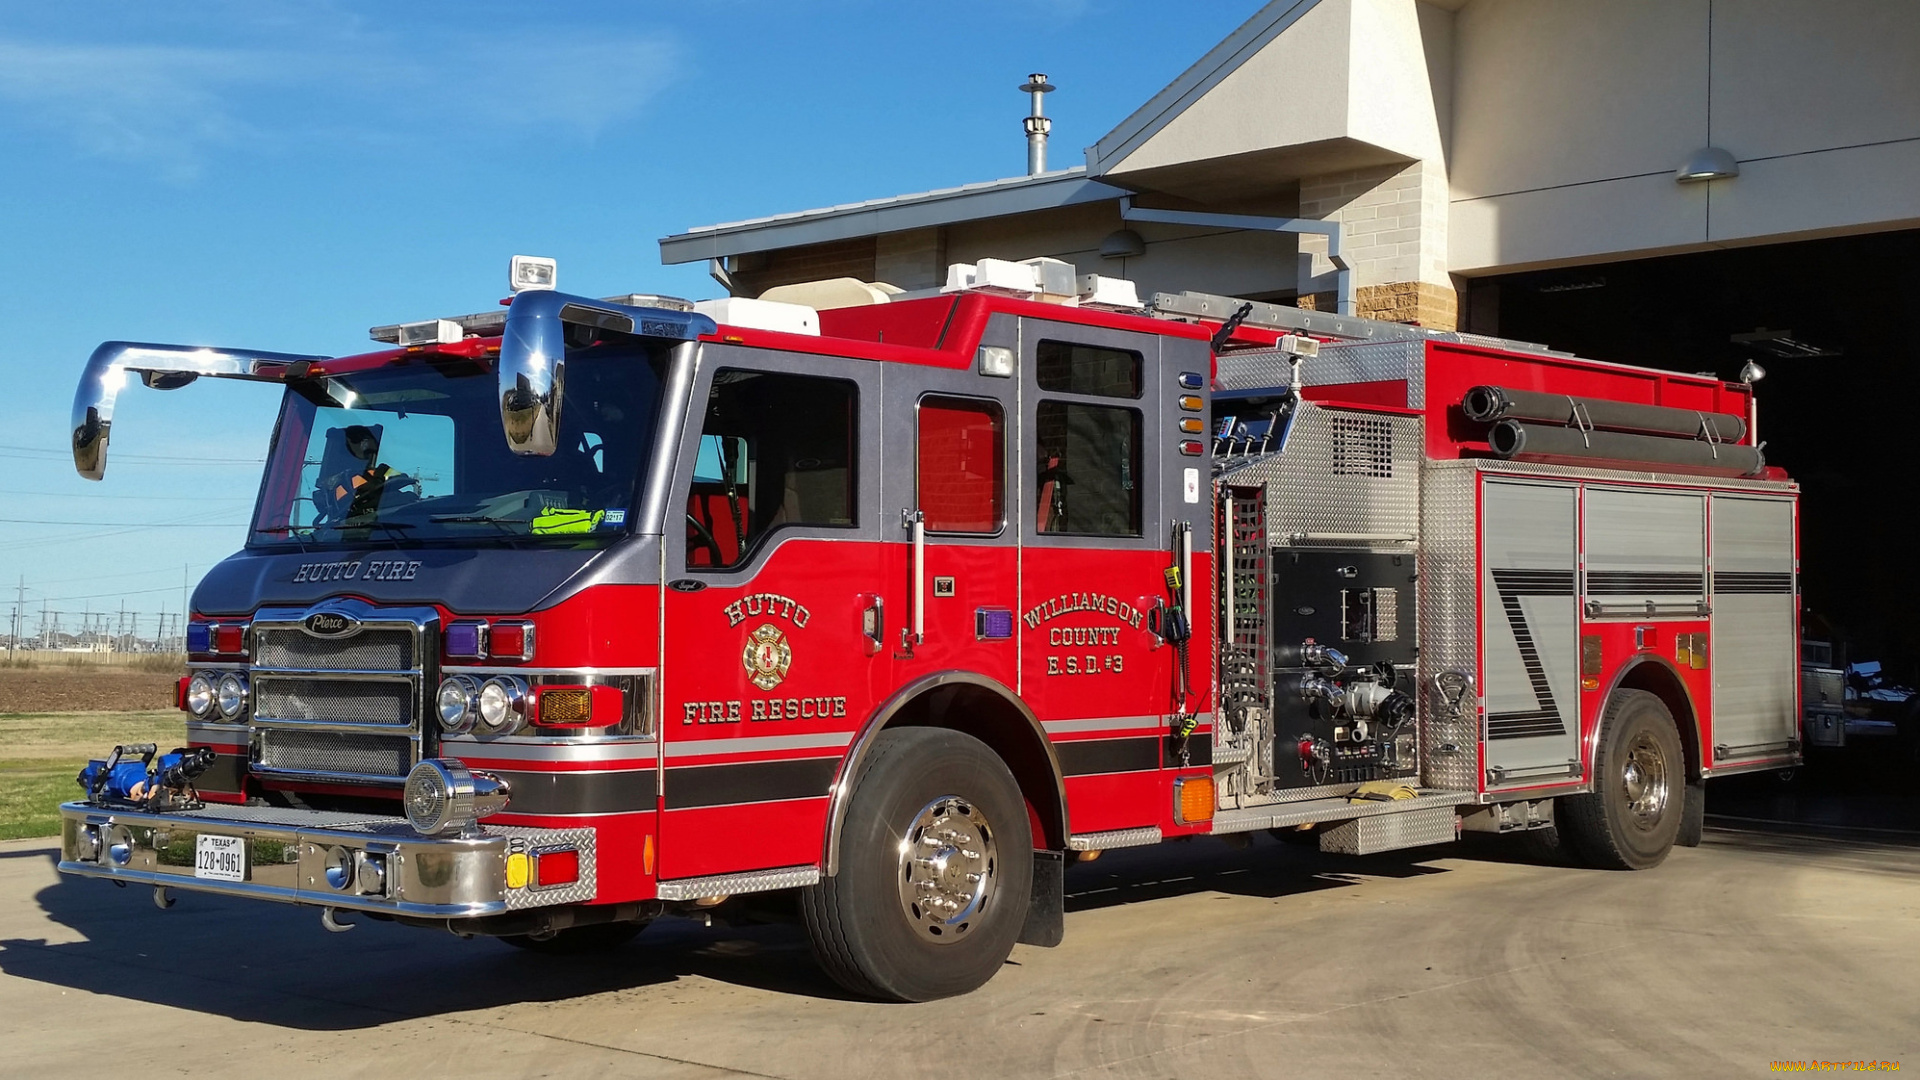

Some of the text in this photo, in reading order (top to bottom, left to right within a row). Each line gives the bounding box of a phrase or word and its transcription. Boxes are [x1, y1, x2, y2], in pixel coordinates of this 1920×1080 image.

[292, 560, 422, 583] HUTTO FIRE
[723, 593, 811, 628] HUTTO
[1022, 592, 1144, 630] WILLIAMSON
[311, 614, 343, 632] Pierce
[1049, 627, 1120, 647] COUNTY
[1104, 654, 1124, 674] #3
[682, 696, 847, 725] FIRE RESCUE
[211, 838, 231, 847] TEXAS
